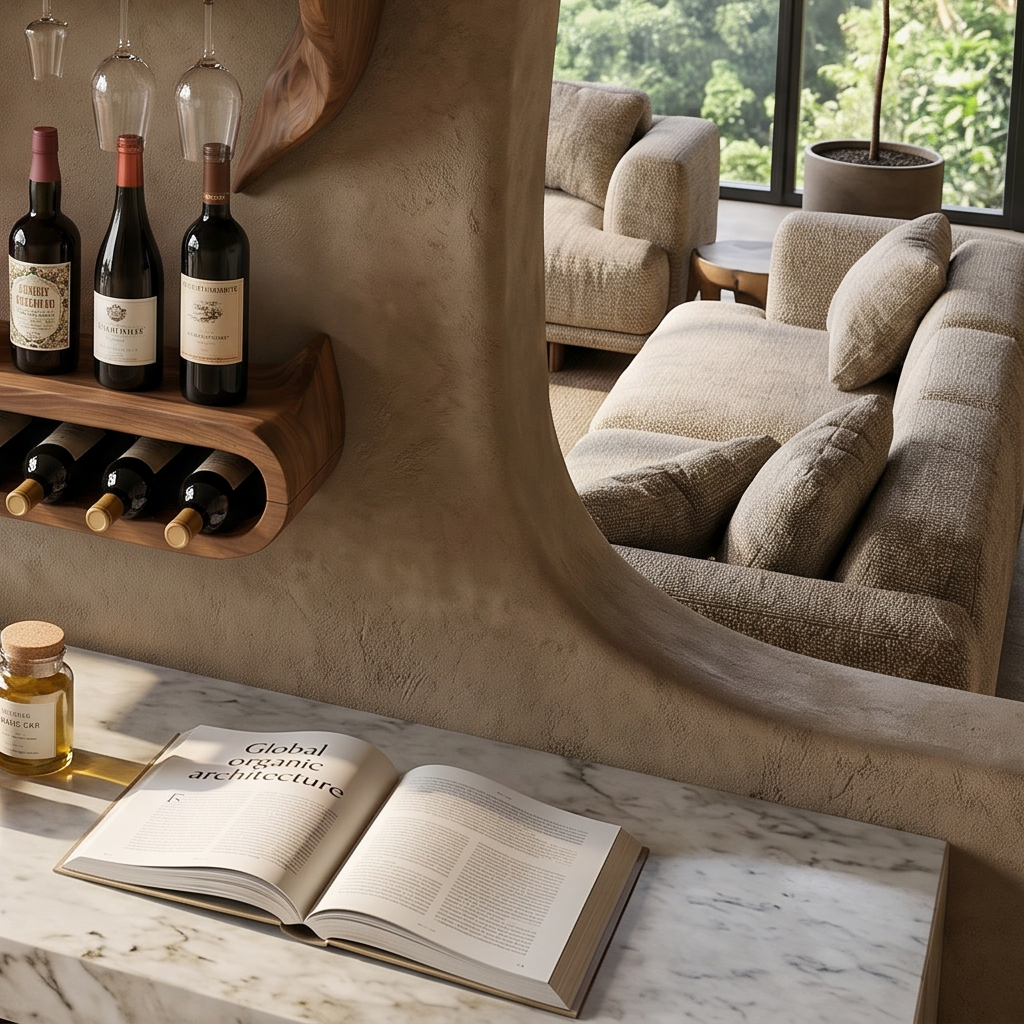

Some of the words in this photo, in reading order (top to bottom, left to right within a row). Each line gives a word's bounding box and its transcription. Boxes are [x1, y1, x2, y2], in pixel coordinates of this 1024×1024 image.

[245, 742, 329, 757] Global
[227, 758, 324, 772] organic
[188, 768, 345, 799] architecture
